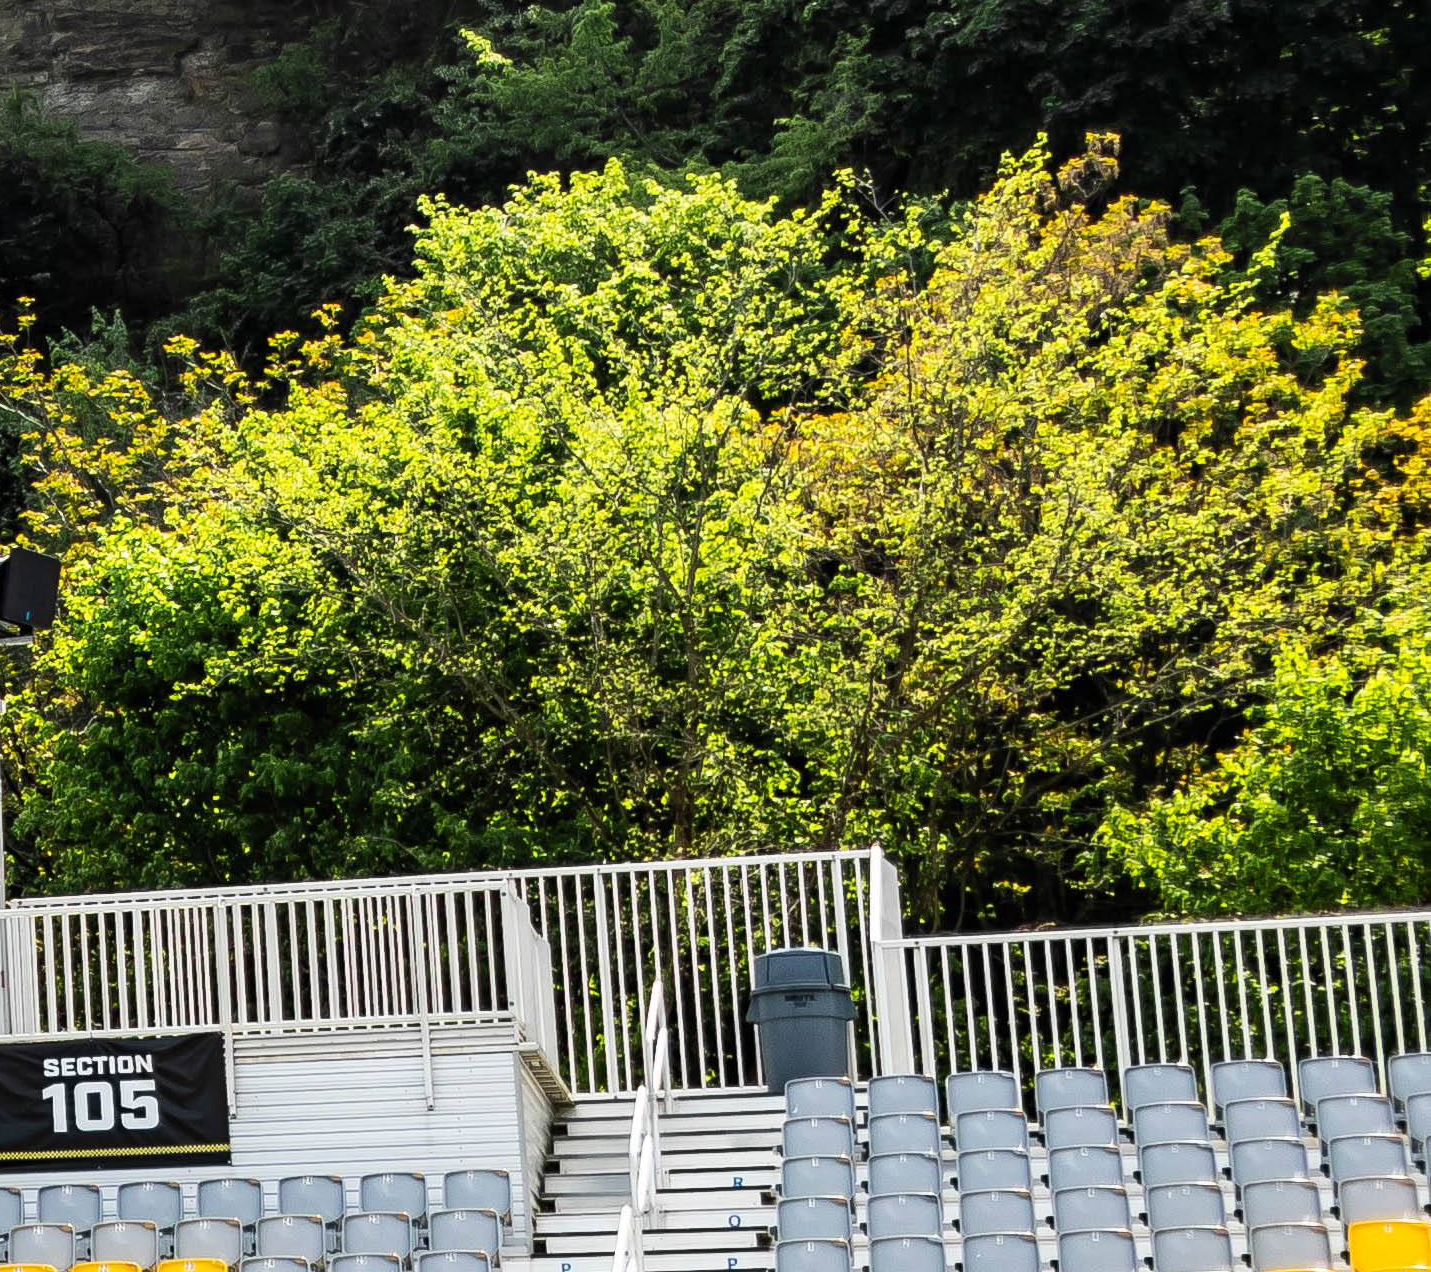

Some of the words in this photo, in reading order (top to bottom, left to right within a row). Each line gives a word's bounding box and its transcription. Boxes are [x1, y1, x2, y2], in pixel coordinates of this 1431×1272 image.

[44, 1054, 153, 1076] SECTION
[43, 1079, 159, 1132] 105
[733, 1177, 743, 1188] R
[728, 1258, 737, 1269] P
